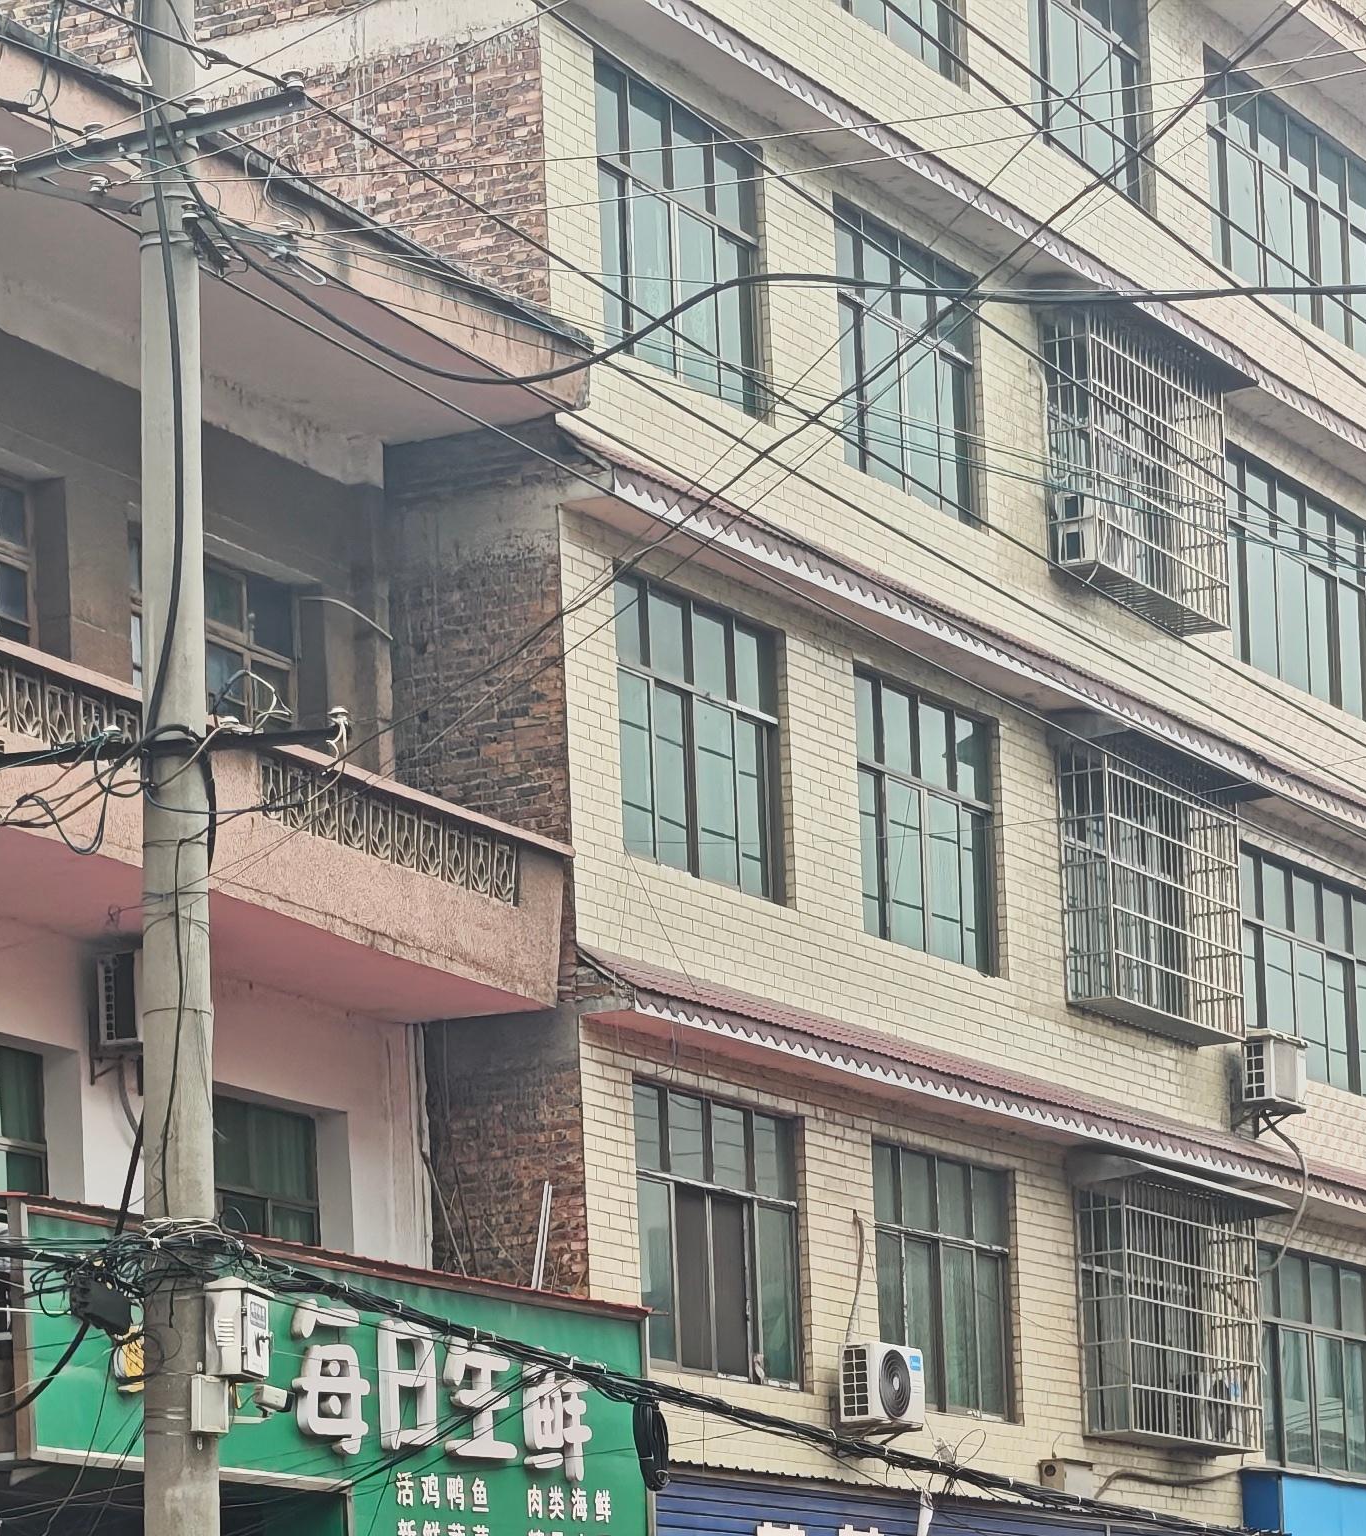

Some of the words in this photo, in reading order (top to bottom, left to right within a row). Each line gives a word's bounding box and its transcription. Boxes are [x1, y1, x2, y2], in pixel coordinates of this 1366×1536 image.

[291, 1298, 593, 1482] 每日生鲜
[396, 1472, 490, 1513] 活鸡鸭鱼
[527, 1484, 612, 1523] 肉类海鲜
